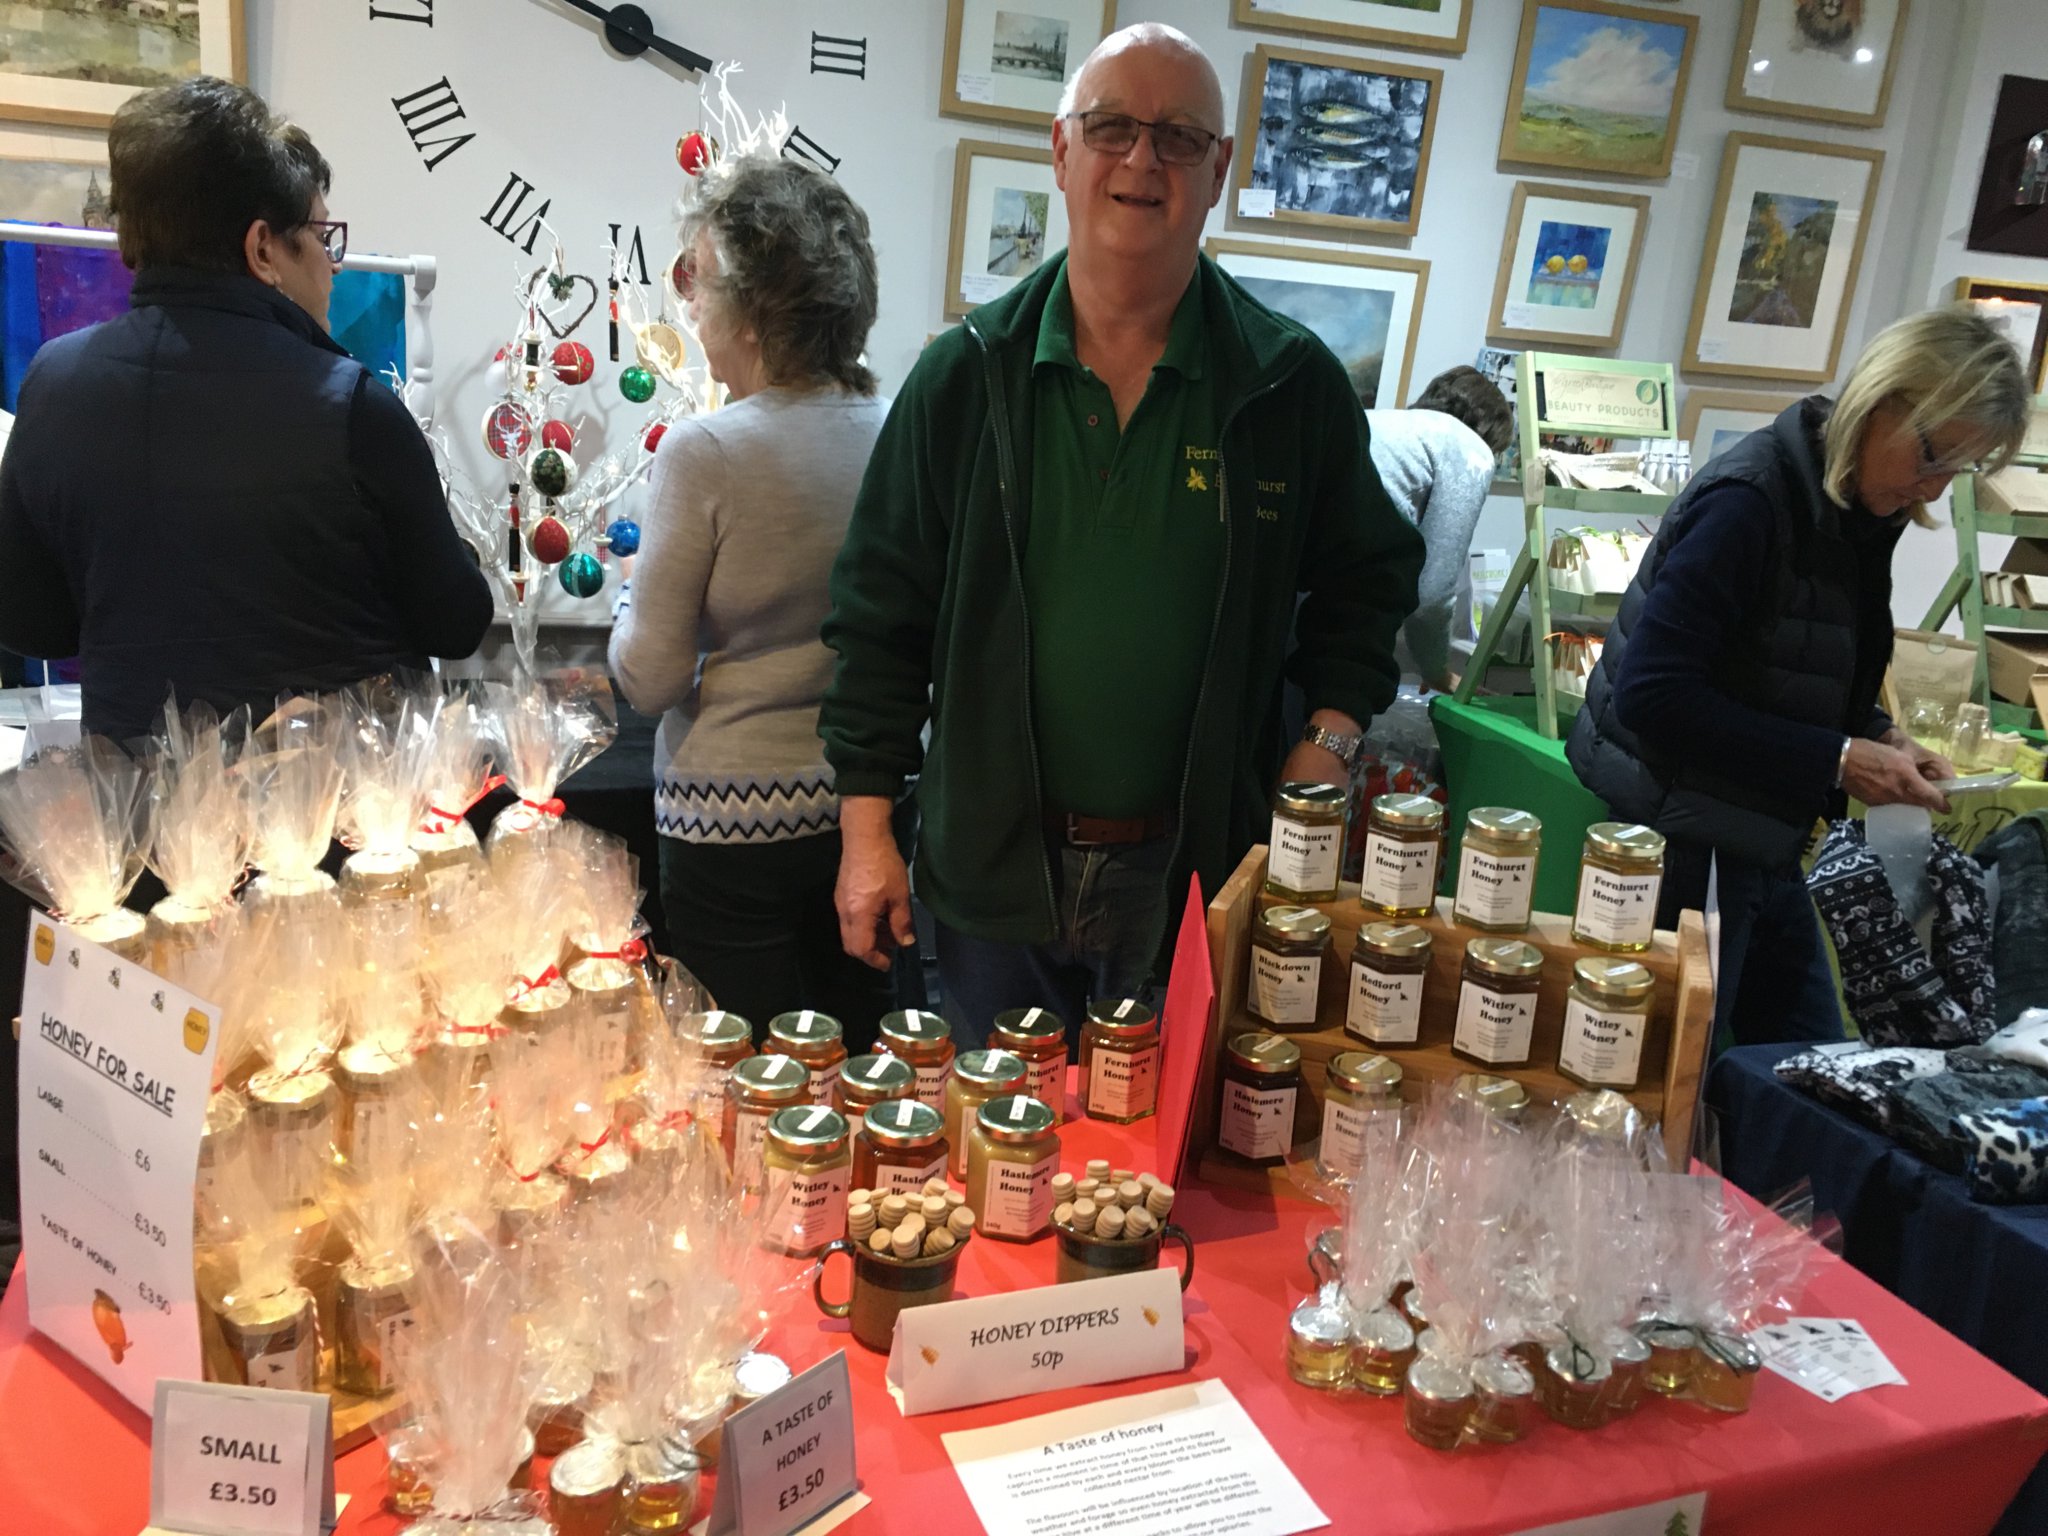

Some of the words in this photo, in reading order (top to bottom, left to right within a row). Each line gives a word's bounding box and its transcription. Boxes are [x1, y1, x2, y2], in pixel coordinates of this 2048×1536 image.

[810, 30, 866, 80] III
[391, 75, 476, 172] VIII
[480, 171, 551, 255] VII
[1548, 400, 1591, 412] BEAUTY
[1598, 404, 1659, 417] PRODUCTS
[1186, 446, 1219, 460] Fern
[1283, 827, 1332, 842] Fernhurst
[1282, 841, 1311, 856] Honey
[1377, 843, 1428, 858] Fernhurst
[1375, 856, 1407, 872] Honey
[1473, 856, 1526, 872] Fernhurst
[1471, 869, 1503, 886] Honey
[1594, 876, 1649, 892] Fernhurst
[1592, 889, 1626, 907] Honey
[1258, 955, 1310, 972] Blackdown
[1258, 968, 1283, 984] Honey
[1361, 973, 1402, 990] Redford
[1360, 987, 1390, 1005] Honey
[1482, 995, 1516, 1011] Witley
[1480, 1010, 1513, 1025] Honey
[1585, 1014, 1621, 1031] Witley
[1583, 1028, 1618, 1044] Honey
[41, 1012, 93, 1059] HONEY
[97, 1046, 127, 1083] FOR
[132, 1071, 176, 1113] SALE
[1105, 1056, 1151, 1068] Fernhurst
[1104, 1069, 1135, 1083] Honey
[1234, 1090, 1283, 1105] Haslemere
[1233, 1102, 1262, 1119] Honey
[135, 1149, 150, 1172] £6
[1001, 1166, 1050, 1180] Haslemere
[792, 1181, 830, 1193] Witley
[1000, 1181, 1034, 1195] Honey
[38, 1149, 66, 1176] SMALL
[134, 1212, 167, 1247] £3.50
[791, 1196, 827, 1207] Honey
[40, 1213, 69, 1243] TASTE
[71, 1236, 84, 1251] OF
[86, 1247, 117, 1276] HONEY
[138, 1282, 172, 1316] £3.50
[970, 1320, 1037, 1347] HONEY
[1040, 1307, 1120, 1336] DIPPERS
[1030, 1350, 1064, 1370] 50p
[762, 1430, 773, 1446] A
[775, 1402, 815, 1437] TASTE
[817, 1390, 834, 1411] OF
[1043, 1446, 1054, 1456] A
[1056, 1438, 1097, 1452] Taste
[1101, 1431, 1115, 1443] of
[1117, 1423, 1164, 1439] honey
[200, 1435, 282, 1465] SMALL
[776, 1432, 821, 1472] HONEY
[210, 1482, 276, 1506] £3.50
[779, 1468, 824, 1512] £3.50
